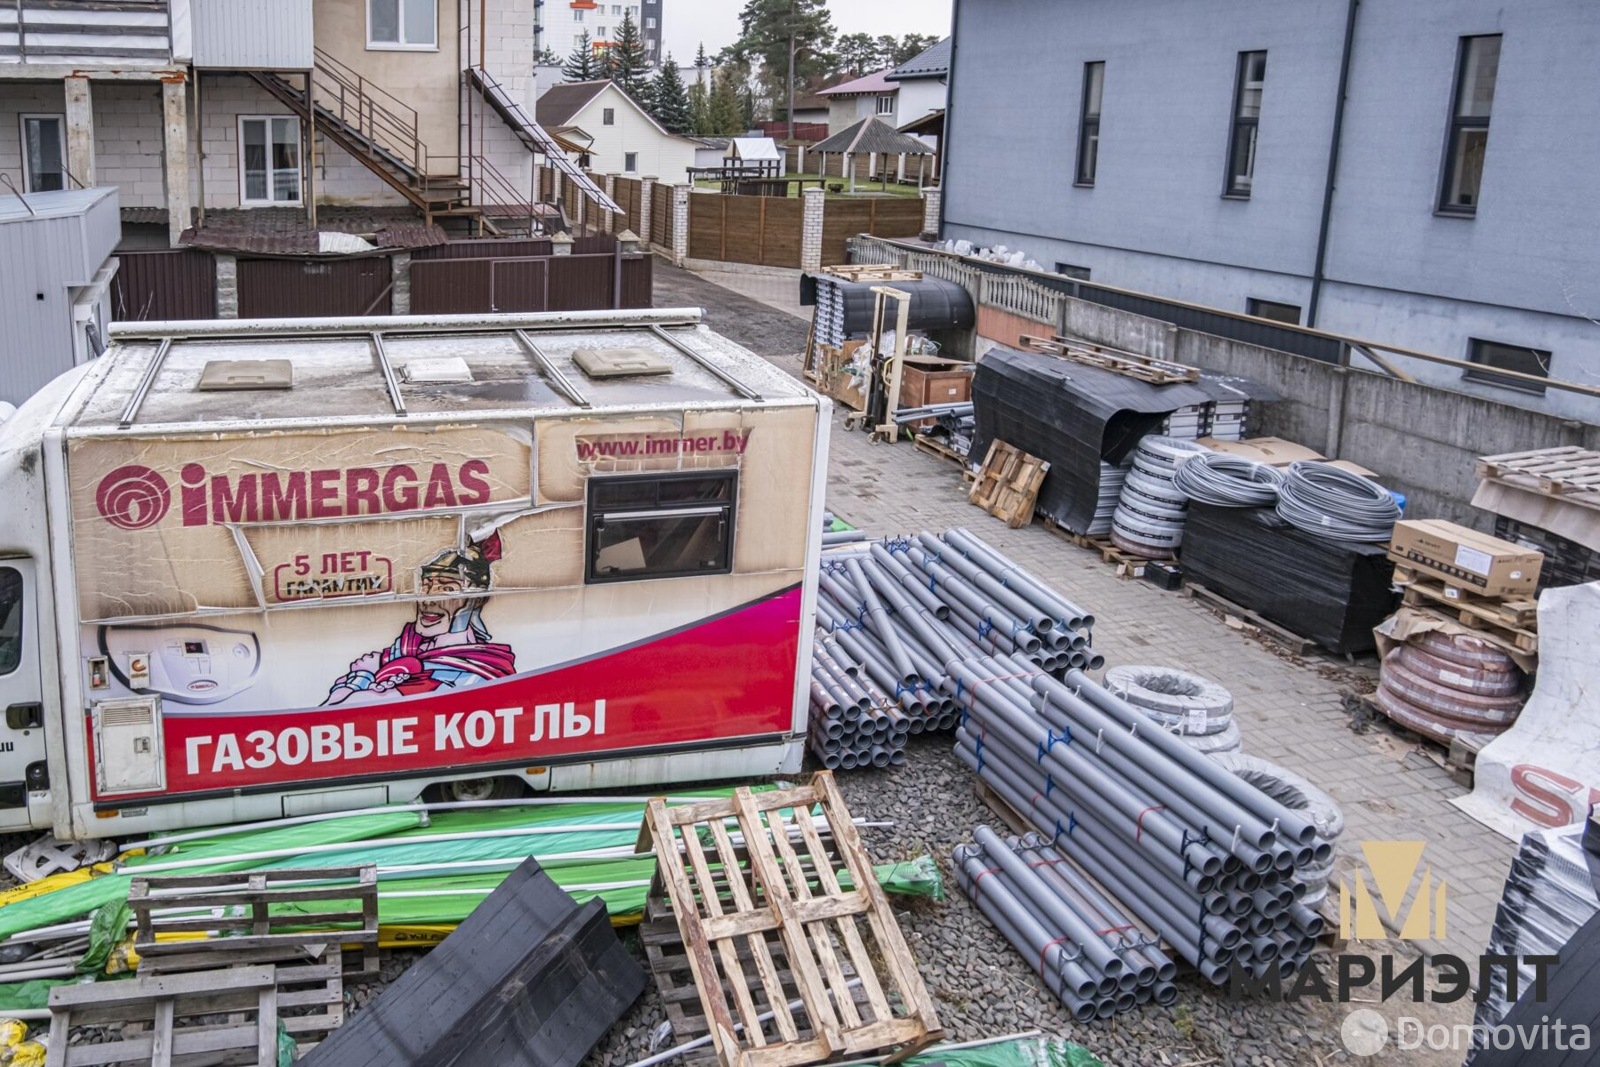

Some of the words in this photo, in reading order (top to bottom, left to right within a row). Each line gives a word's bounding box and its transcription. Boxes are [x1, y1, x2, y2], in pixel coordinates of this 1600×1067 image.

[576, 430, 749, 459] www.immer.by
[294, 554, 311, 576] 5
[320, 550, 372, 575] ЛЕТ
[184, 716, 419, 776] ГАЗОВЫЕ
